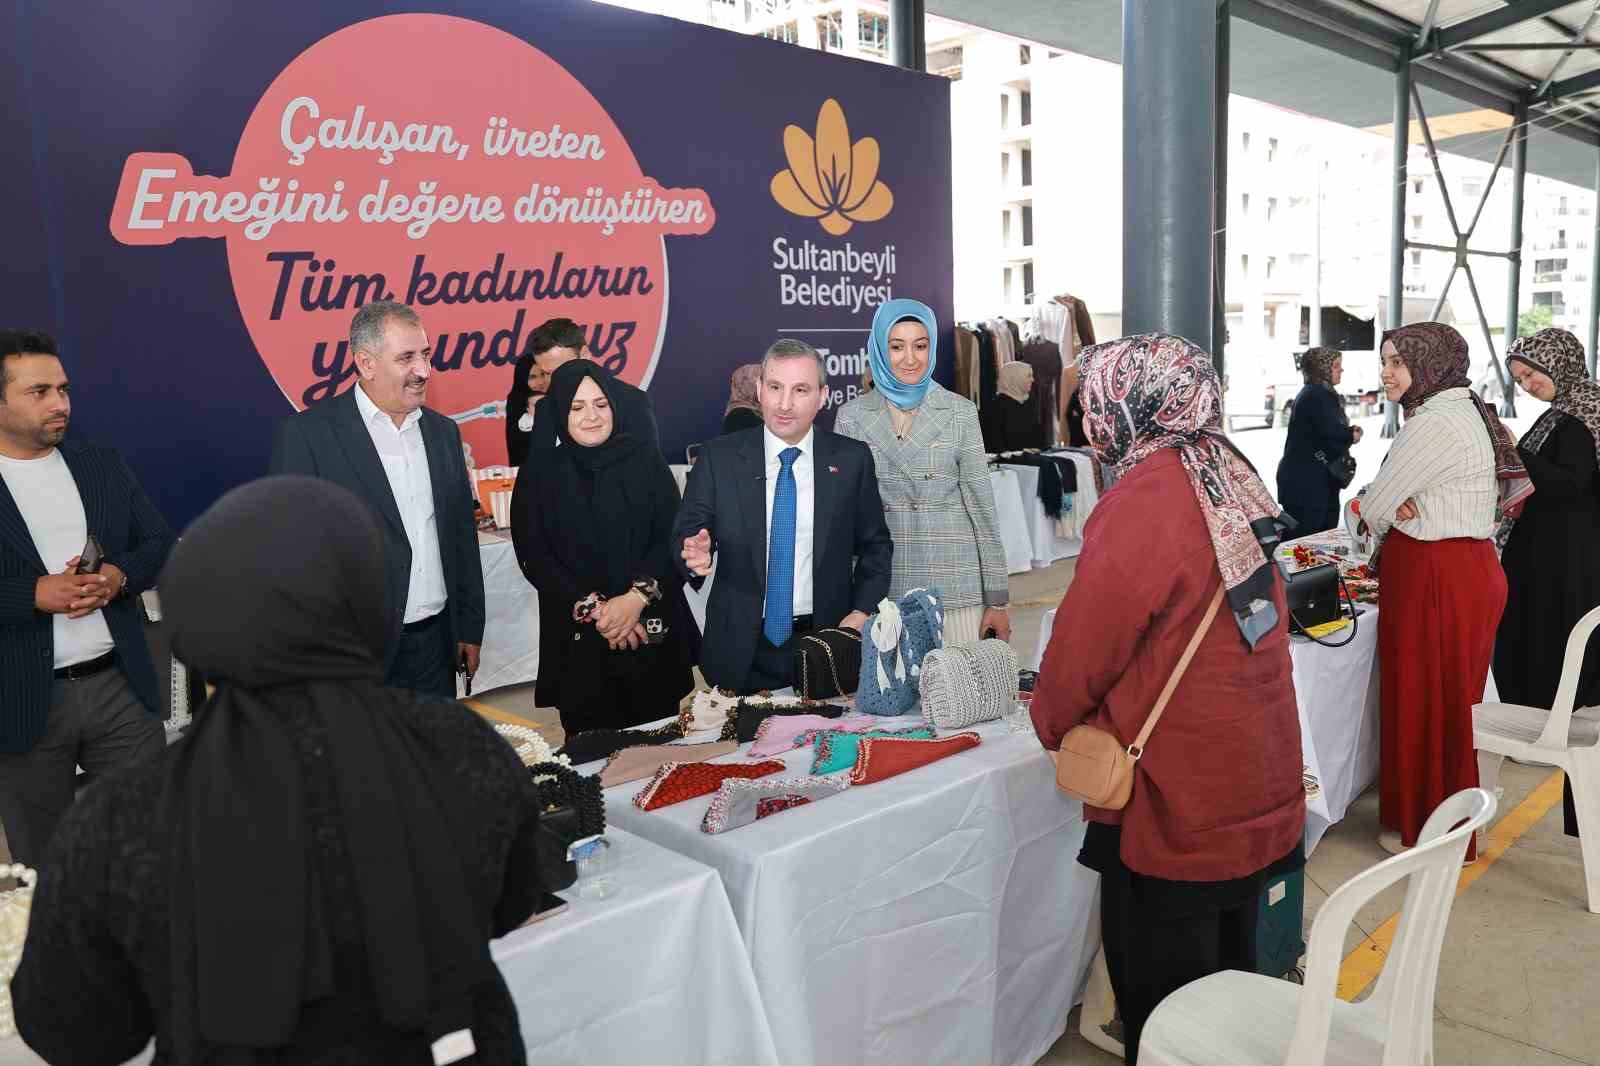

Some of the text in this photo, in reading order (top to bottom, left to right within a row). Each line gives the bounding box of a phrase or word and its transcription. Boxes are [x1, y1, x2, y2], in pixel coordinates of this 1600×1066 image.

[281, 96, 606, 166] Çalışan, üreten
[128, 169, 706, 241] Emeğini değere dönüştüren
[266, 251, 653, 321] Tüm kadınların
[772, 236, 896, 281] Sultanbeyli
[780, 273, 892, 314] Belediyesi
